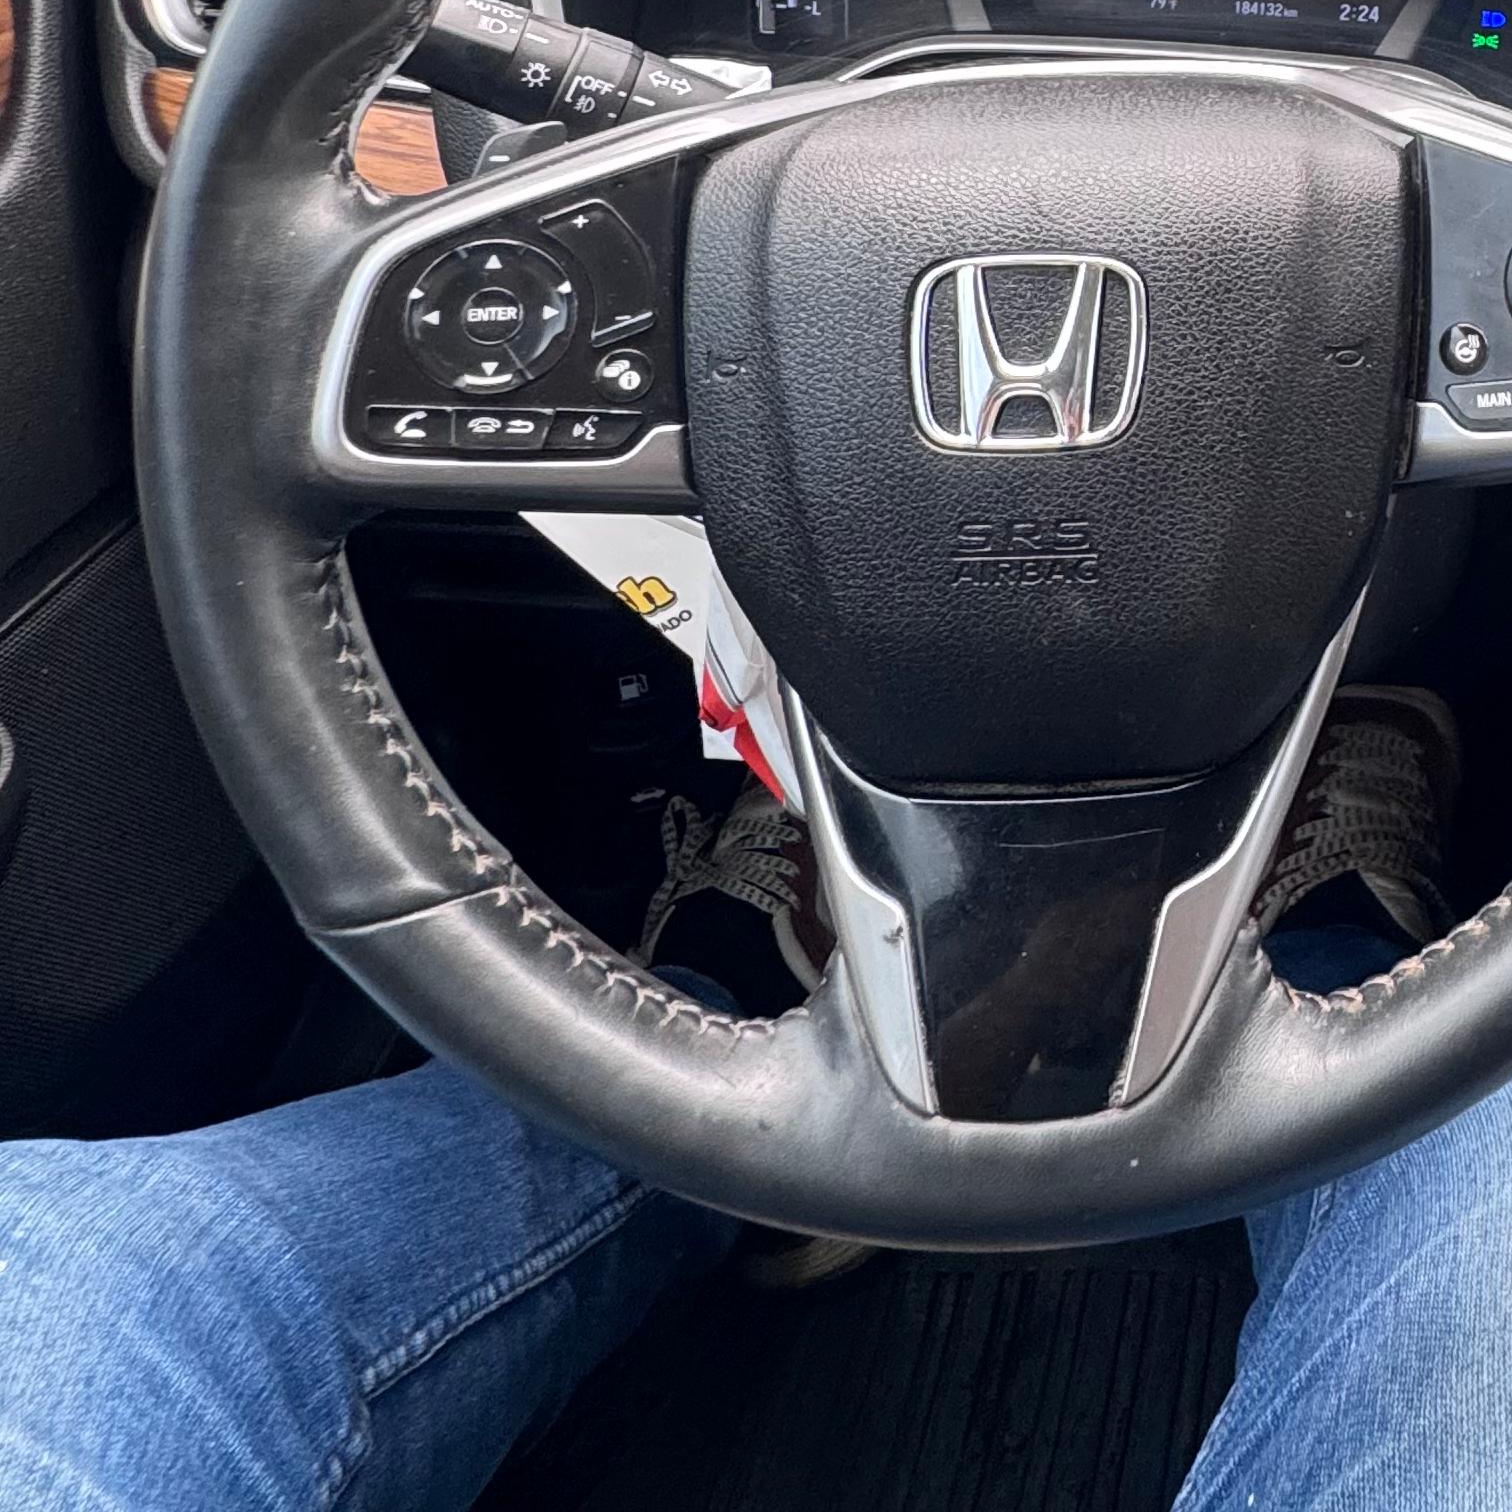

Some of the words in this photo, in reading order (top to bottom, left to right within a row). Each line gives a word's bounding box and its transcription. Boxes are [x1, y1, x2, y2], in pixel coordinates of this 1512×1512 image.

[1339, 3, 1380, 23] 2:24
[580, 75, 616, 96] OFF
[467, 306, 518, 322] ENTER
[1476, 390, 1512, 408] MAIN
[957, 521, 1090, 554] SRS
[951, 559, 1099, 586] AIRBAG
